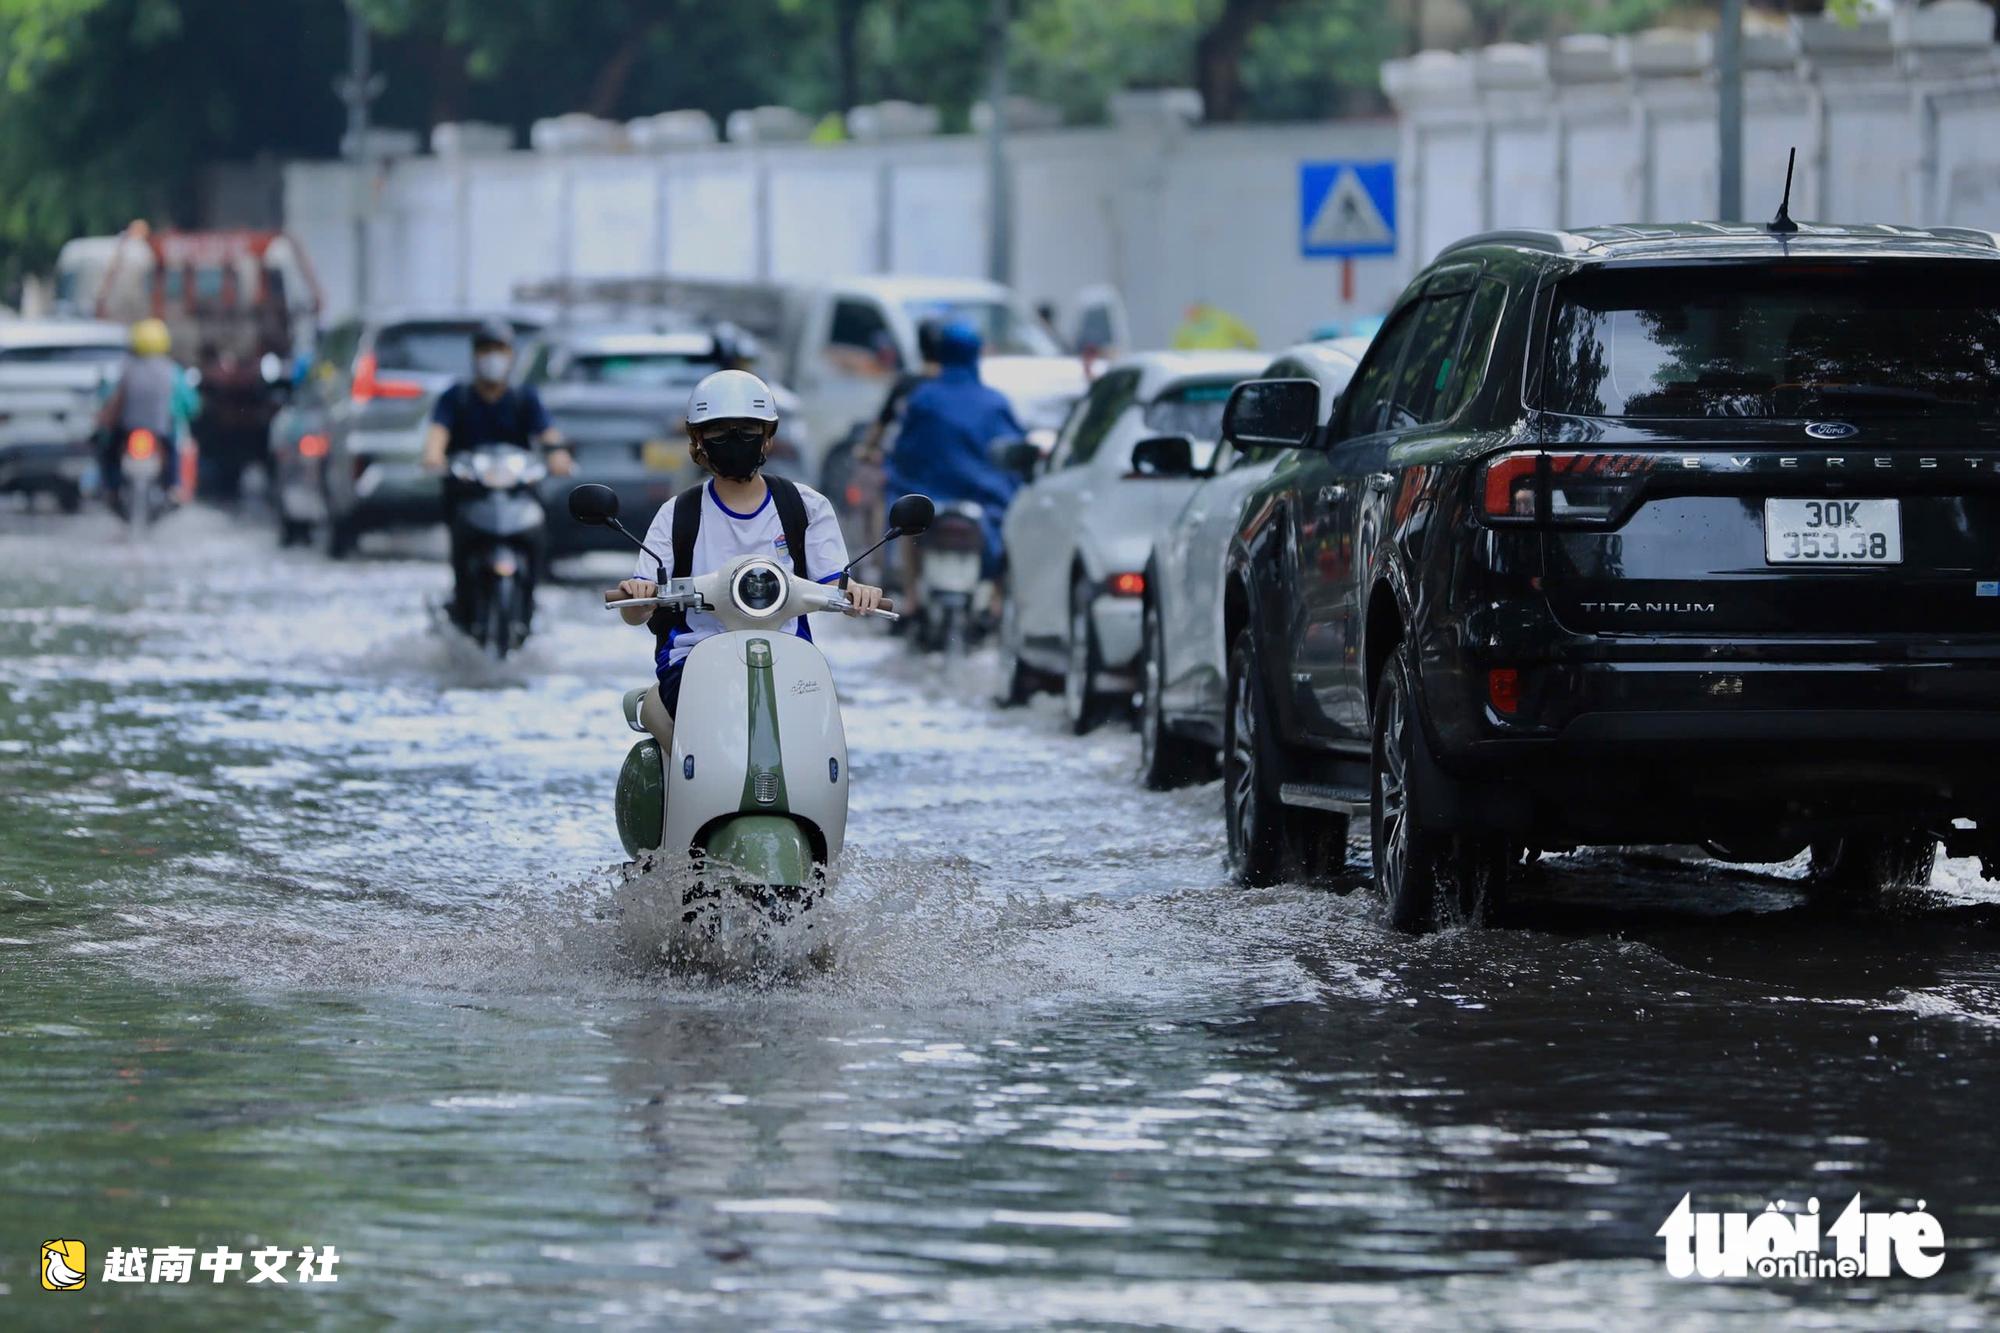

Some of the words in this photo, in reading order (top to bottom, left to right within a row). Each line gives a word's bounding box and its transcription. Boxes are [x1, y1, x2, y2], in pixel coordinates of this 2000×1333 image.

[1682, 457, 1983, 468] EVEREST
[1805, 502, 1861, 528] 30K
[1783, 533, 1887, 559] 353.38
[1580, 602, 1715, 612] TITANIUM
